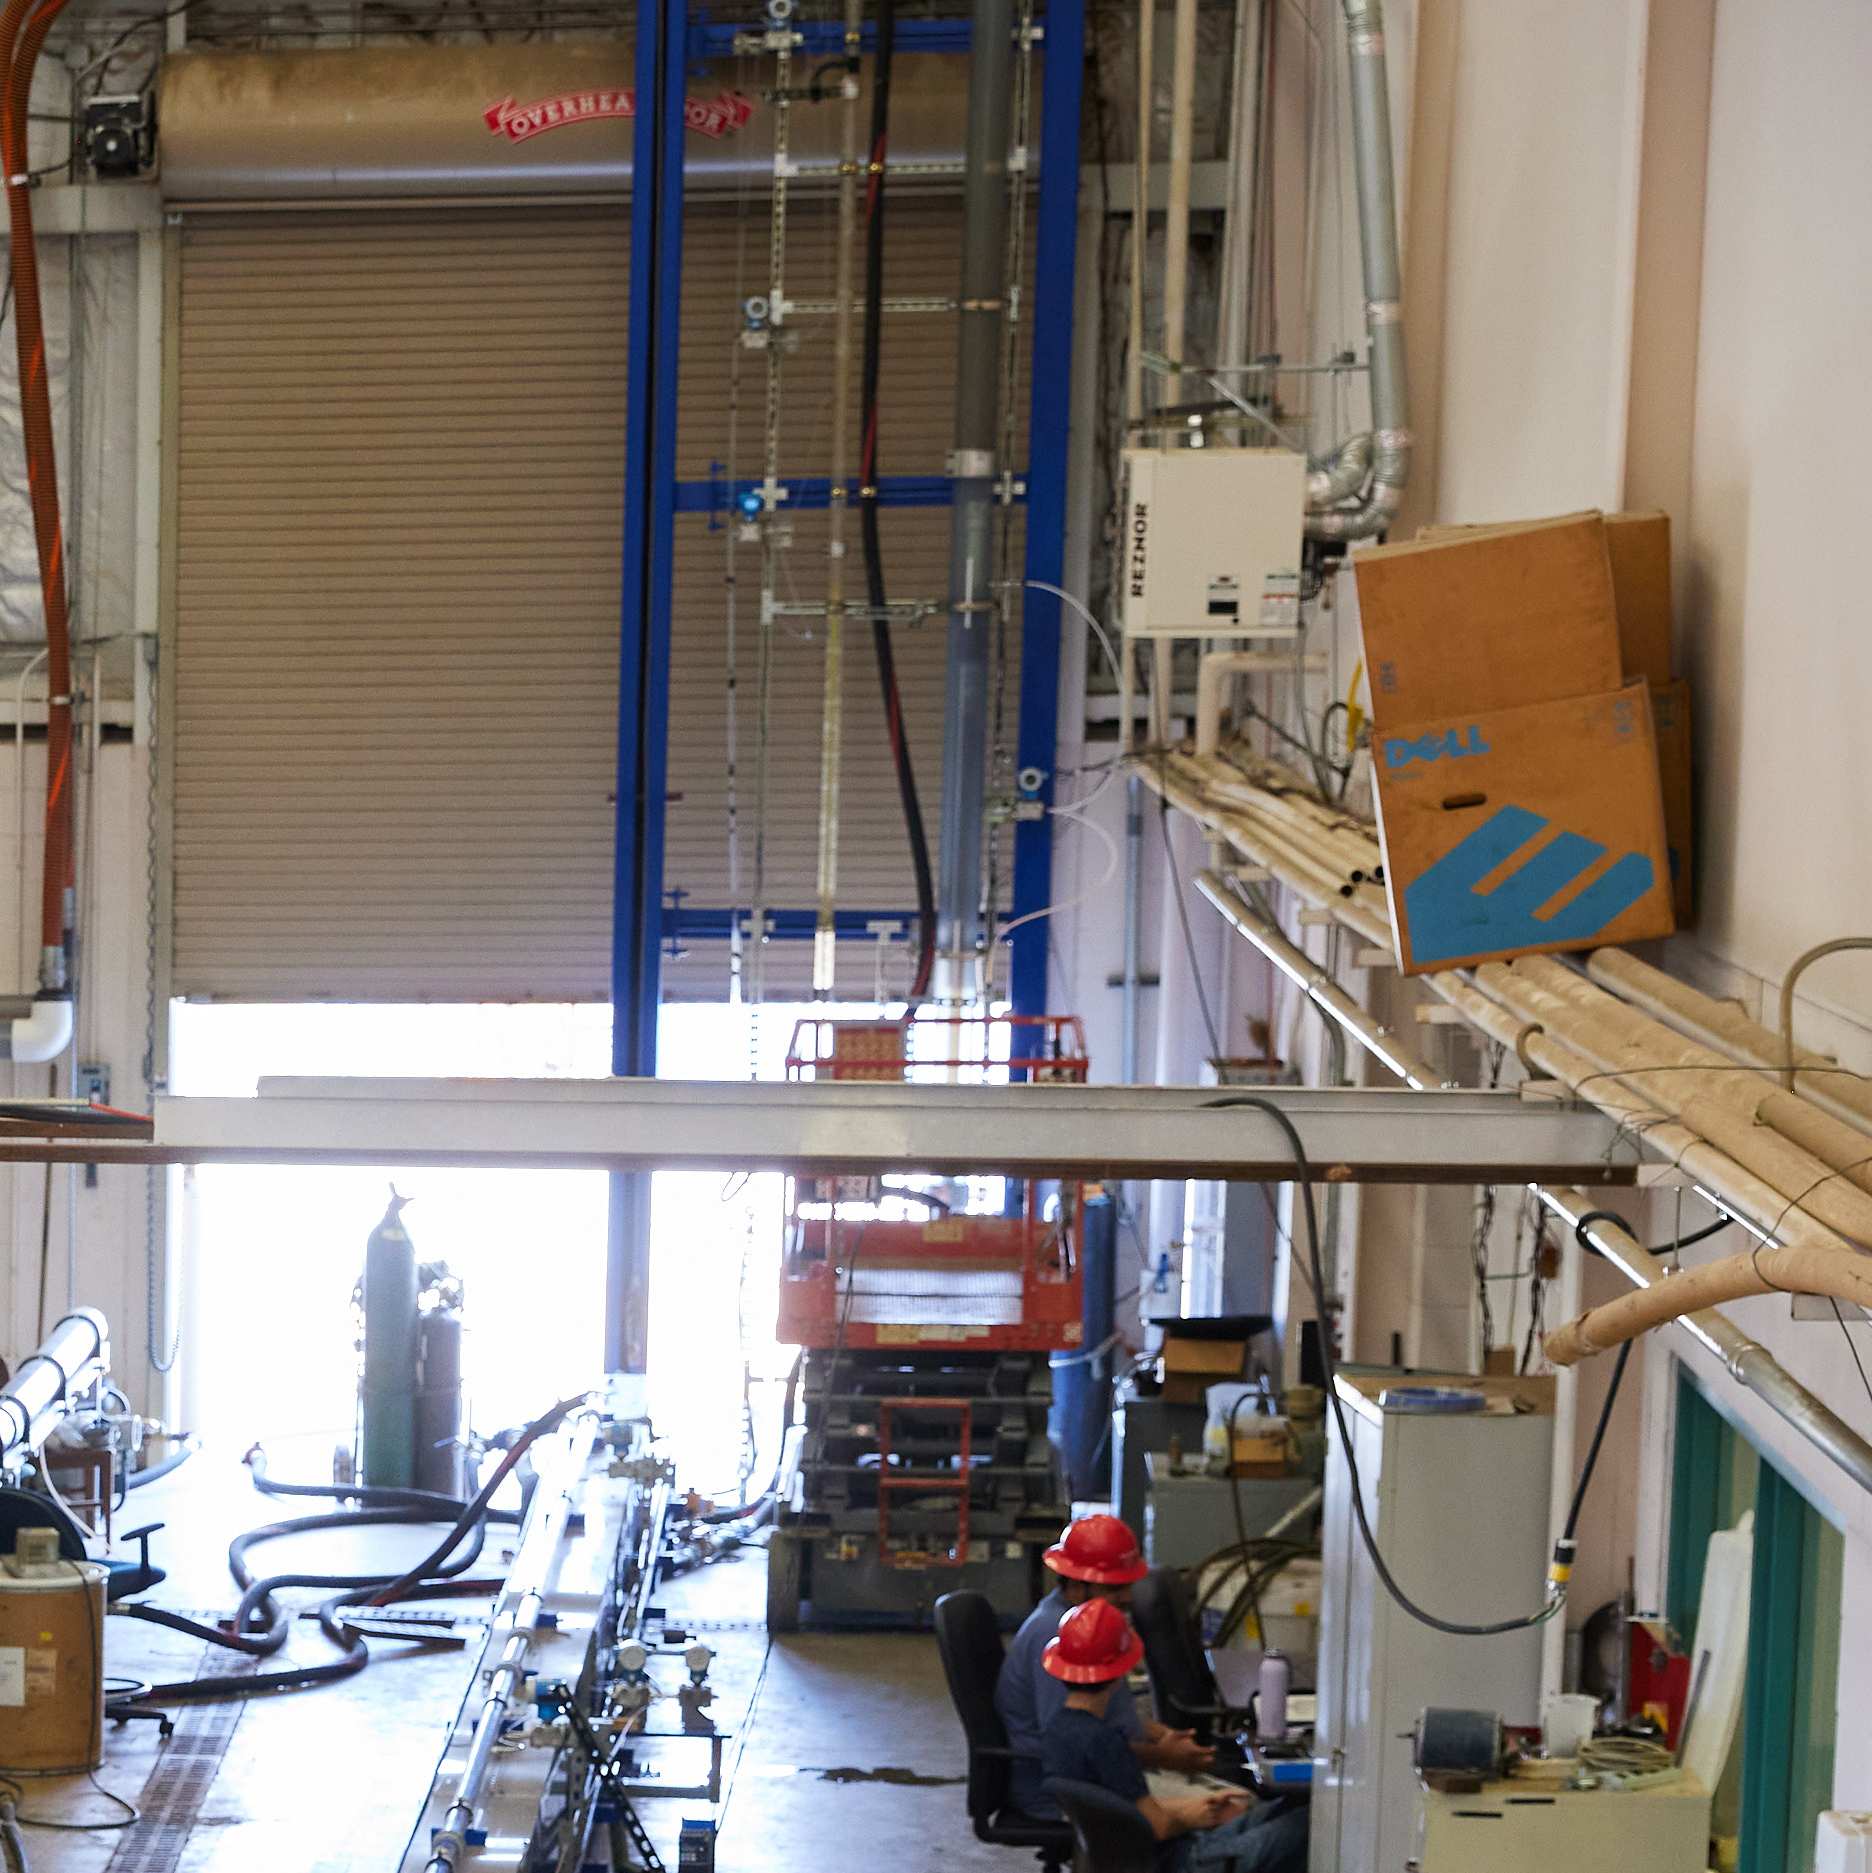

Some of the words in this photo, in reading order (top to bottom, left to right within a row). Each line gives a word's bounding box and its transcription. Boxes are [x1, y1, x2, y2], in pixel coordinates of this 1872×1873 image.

[509, 91, 634, 136] OVERHEA
[1130, 503, 1148, 597] REZNOR
[1384, 725, 1491, 769] DELL
